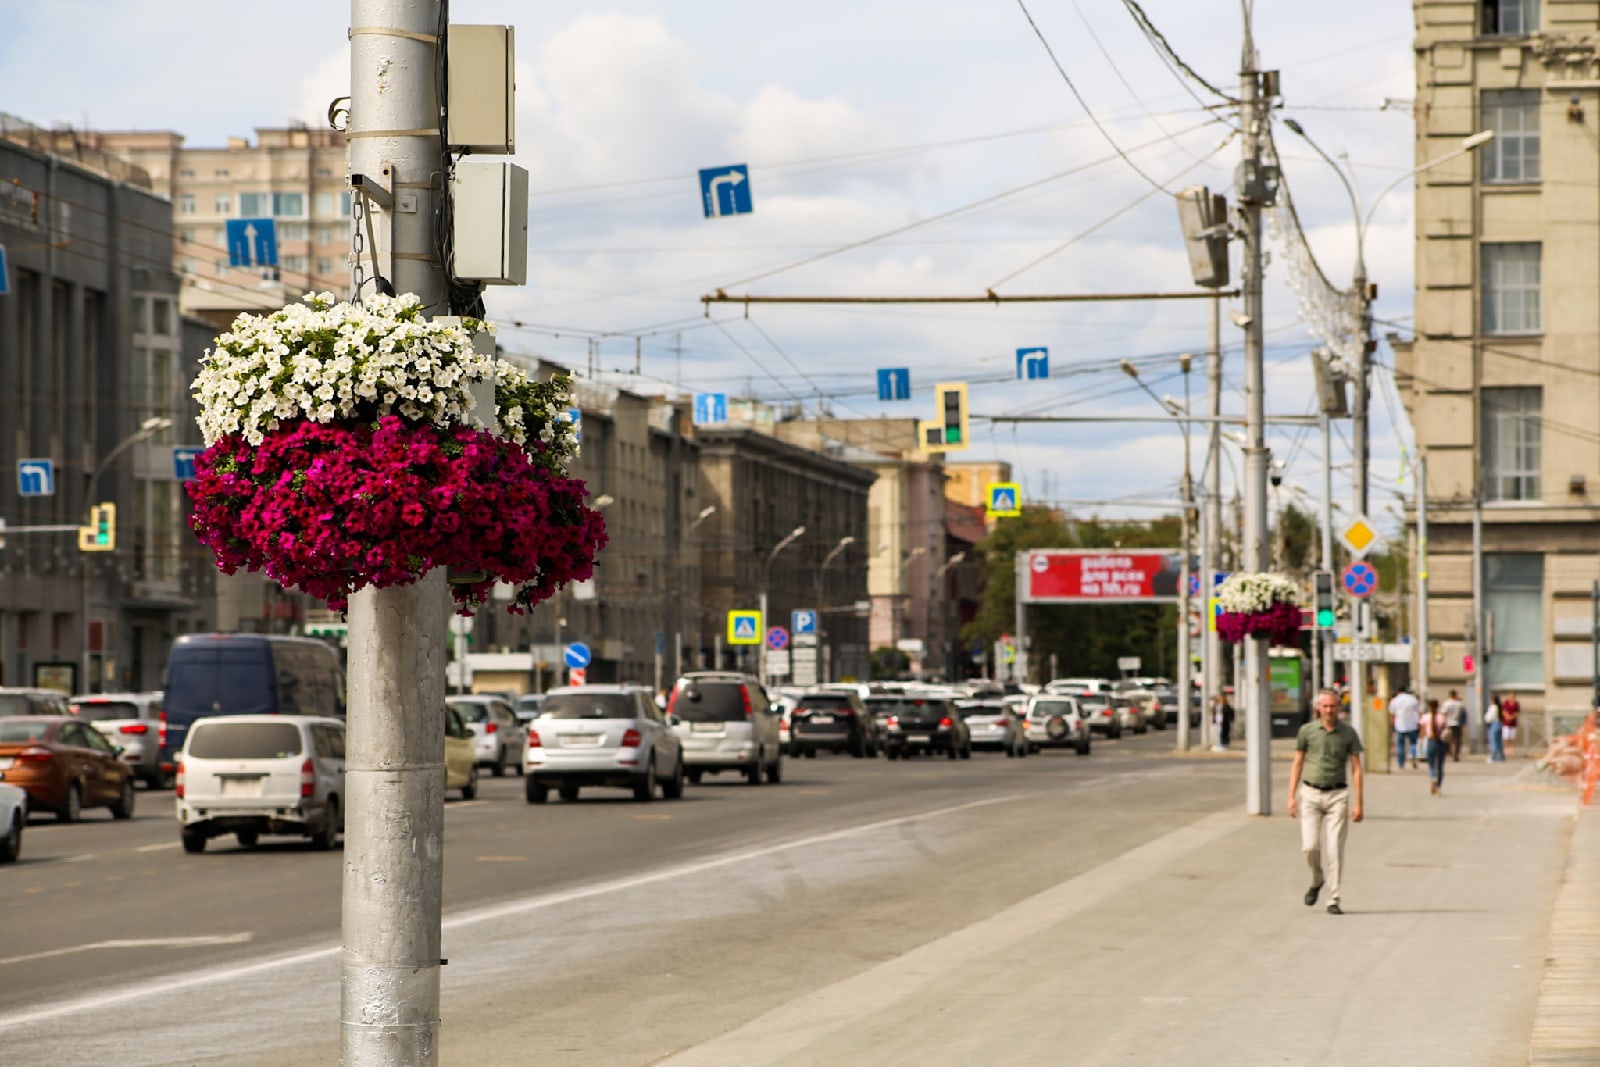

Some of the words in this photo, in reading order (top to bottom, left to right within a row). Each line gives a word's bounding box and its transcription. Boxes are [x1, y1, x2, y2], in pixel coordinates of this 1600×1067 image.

[1081, 557, 1132, 570] работа
[1081, 571, 1109, 583] для
[1111, 571, 1145, 582] всех
[1081, 584, 1099, 595] на
[1102, 582, 1141, 595] hh.ru
[797, 613, 811, 632] P
